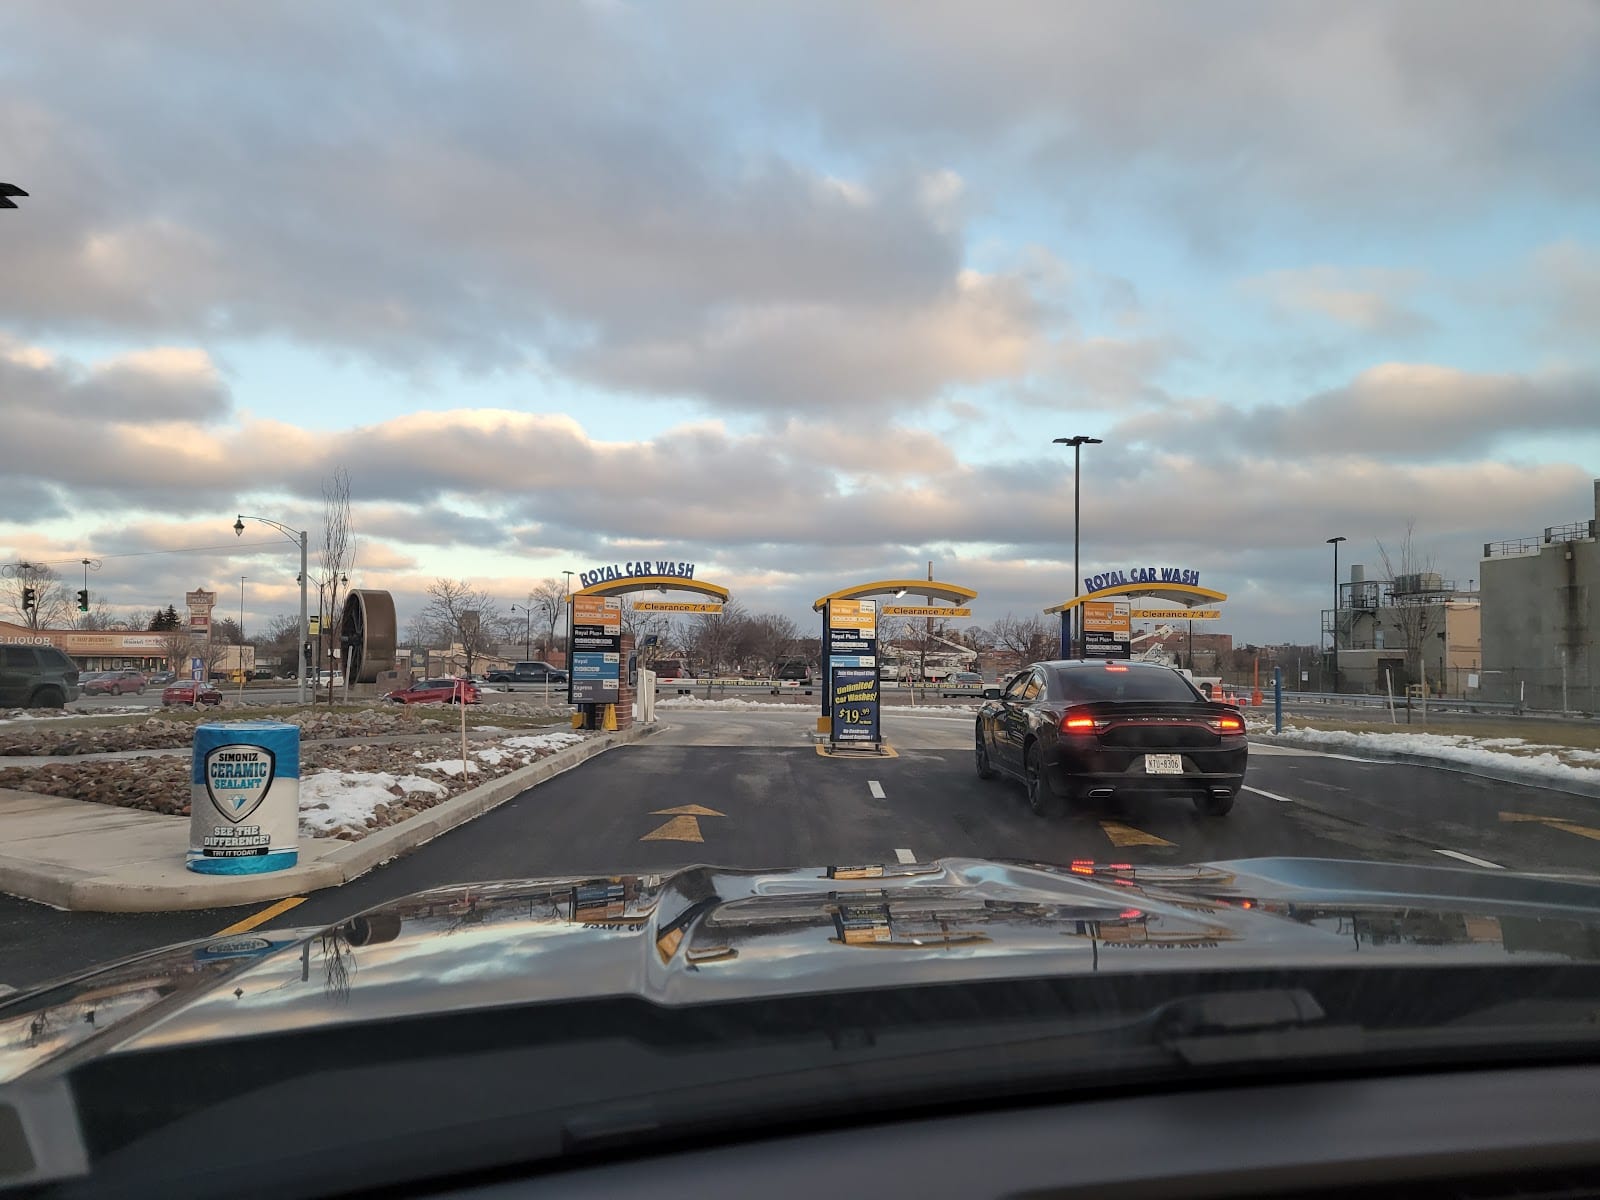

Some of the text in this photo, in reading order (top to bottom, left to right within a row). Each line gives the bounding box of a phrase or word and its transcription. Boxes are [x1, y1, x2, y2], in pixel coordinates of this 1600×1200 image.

[579, 561, 695, 589] ROYAL CAR WASH
[1084, 568, 1200, 594] ROYAL CAR WASH
[644, 603, 690, 611] Clearance
[893, 607, 939, 615] Clearance
[1142, 610, 1188, 618] Clearance
[836, 680, 875, 695] Unlimited
[219, 753, 258, 762] SIMONIZ
[210, 762, 267, 778] CERAMIC
[214, 778, 261, 788] SEALANT
[214, 825, 261, 837] SEE THE
[204, 835, 271, 847] DIFFERENCE!
[233, 849, 258, 857] TODAY!
